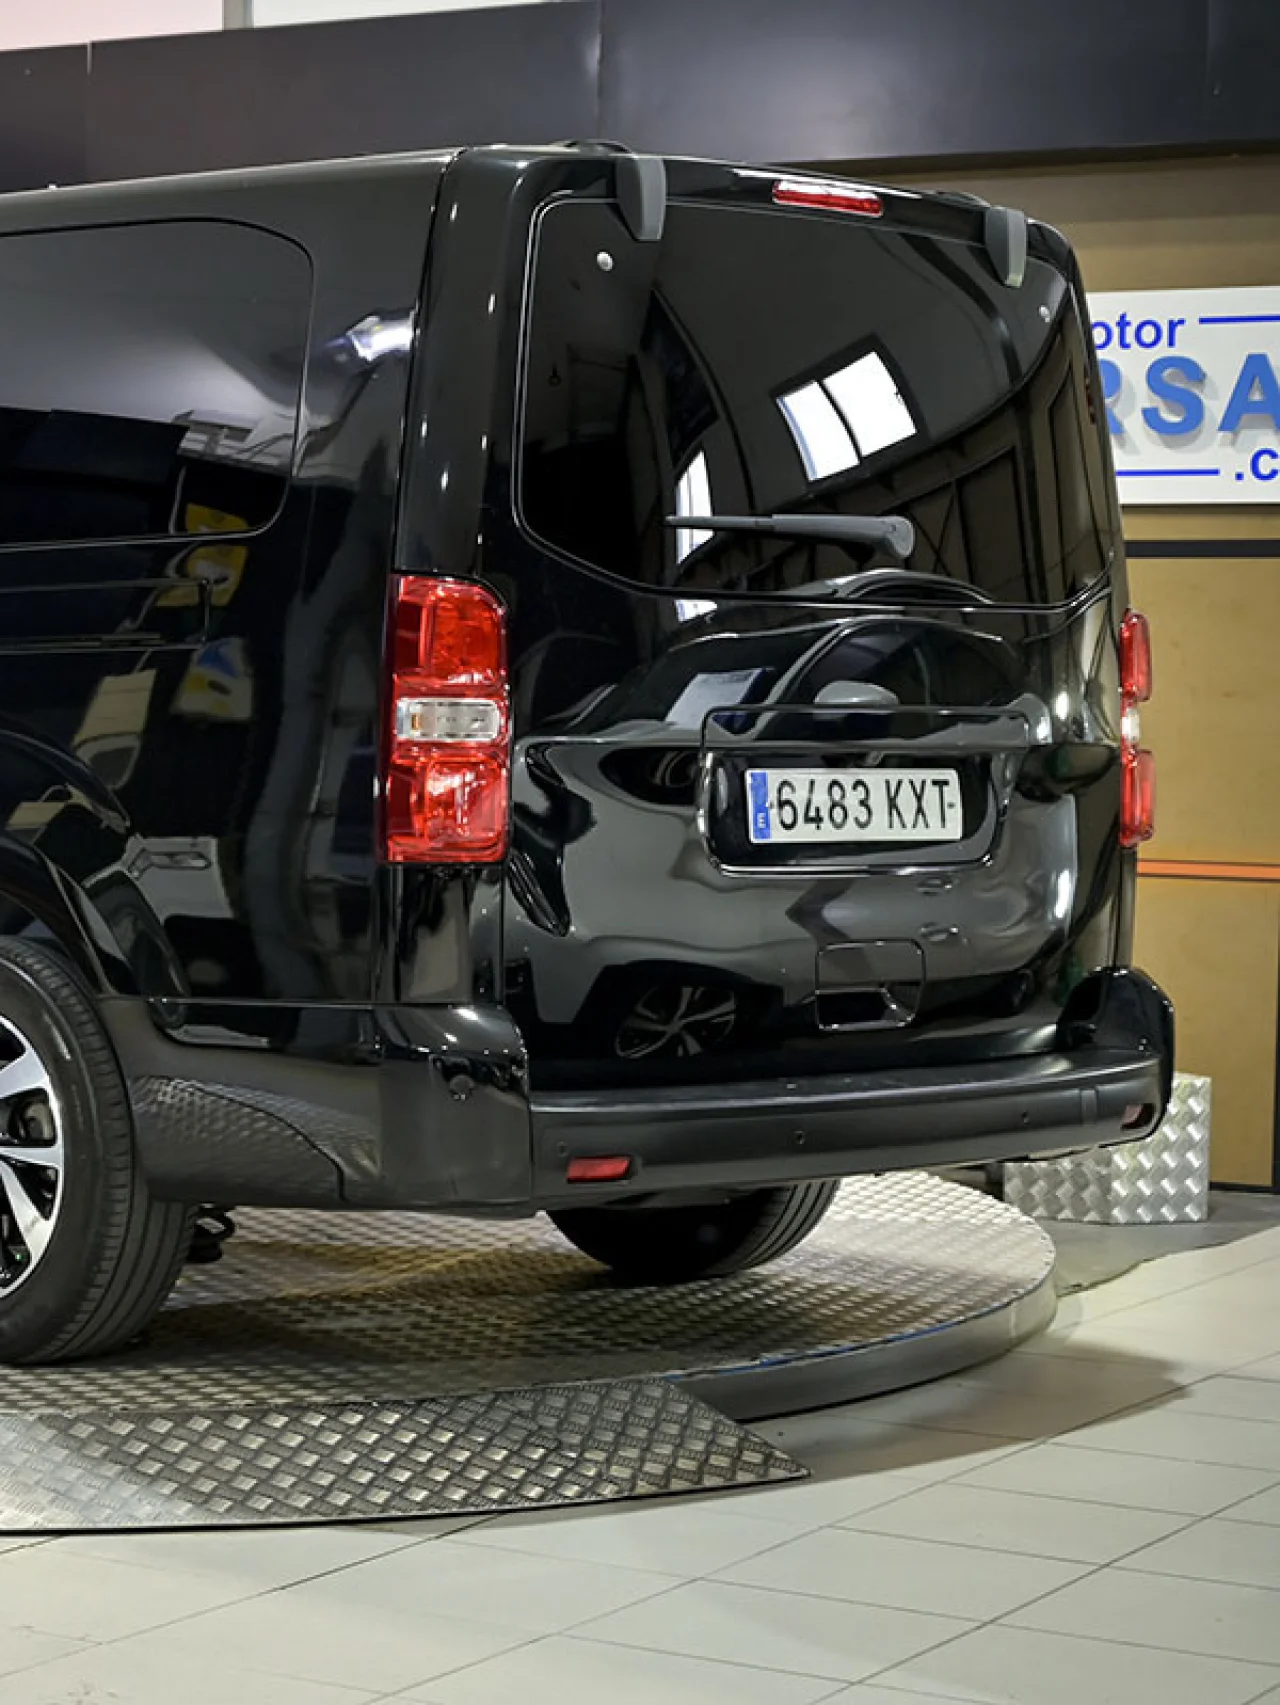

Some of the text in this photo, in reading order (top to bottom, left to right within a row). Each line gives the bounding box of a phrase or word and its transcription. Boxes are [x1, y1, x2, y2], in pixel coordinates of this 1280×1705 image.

[1091, 312, 1185, 350] otor
[756, 812, 767, 829] E
[777, 778, 950, 830] 6483 KXT
